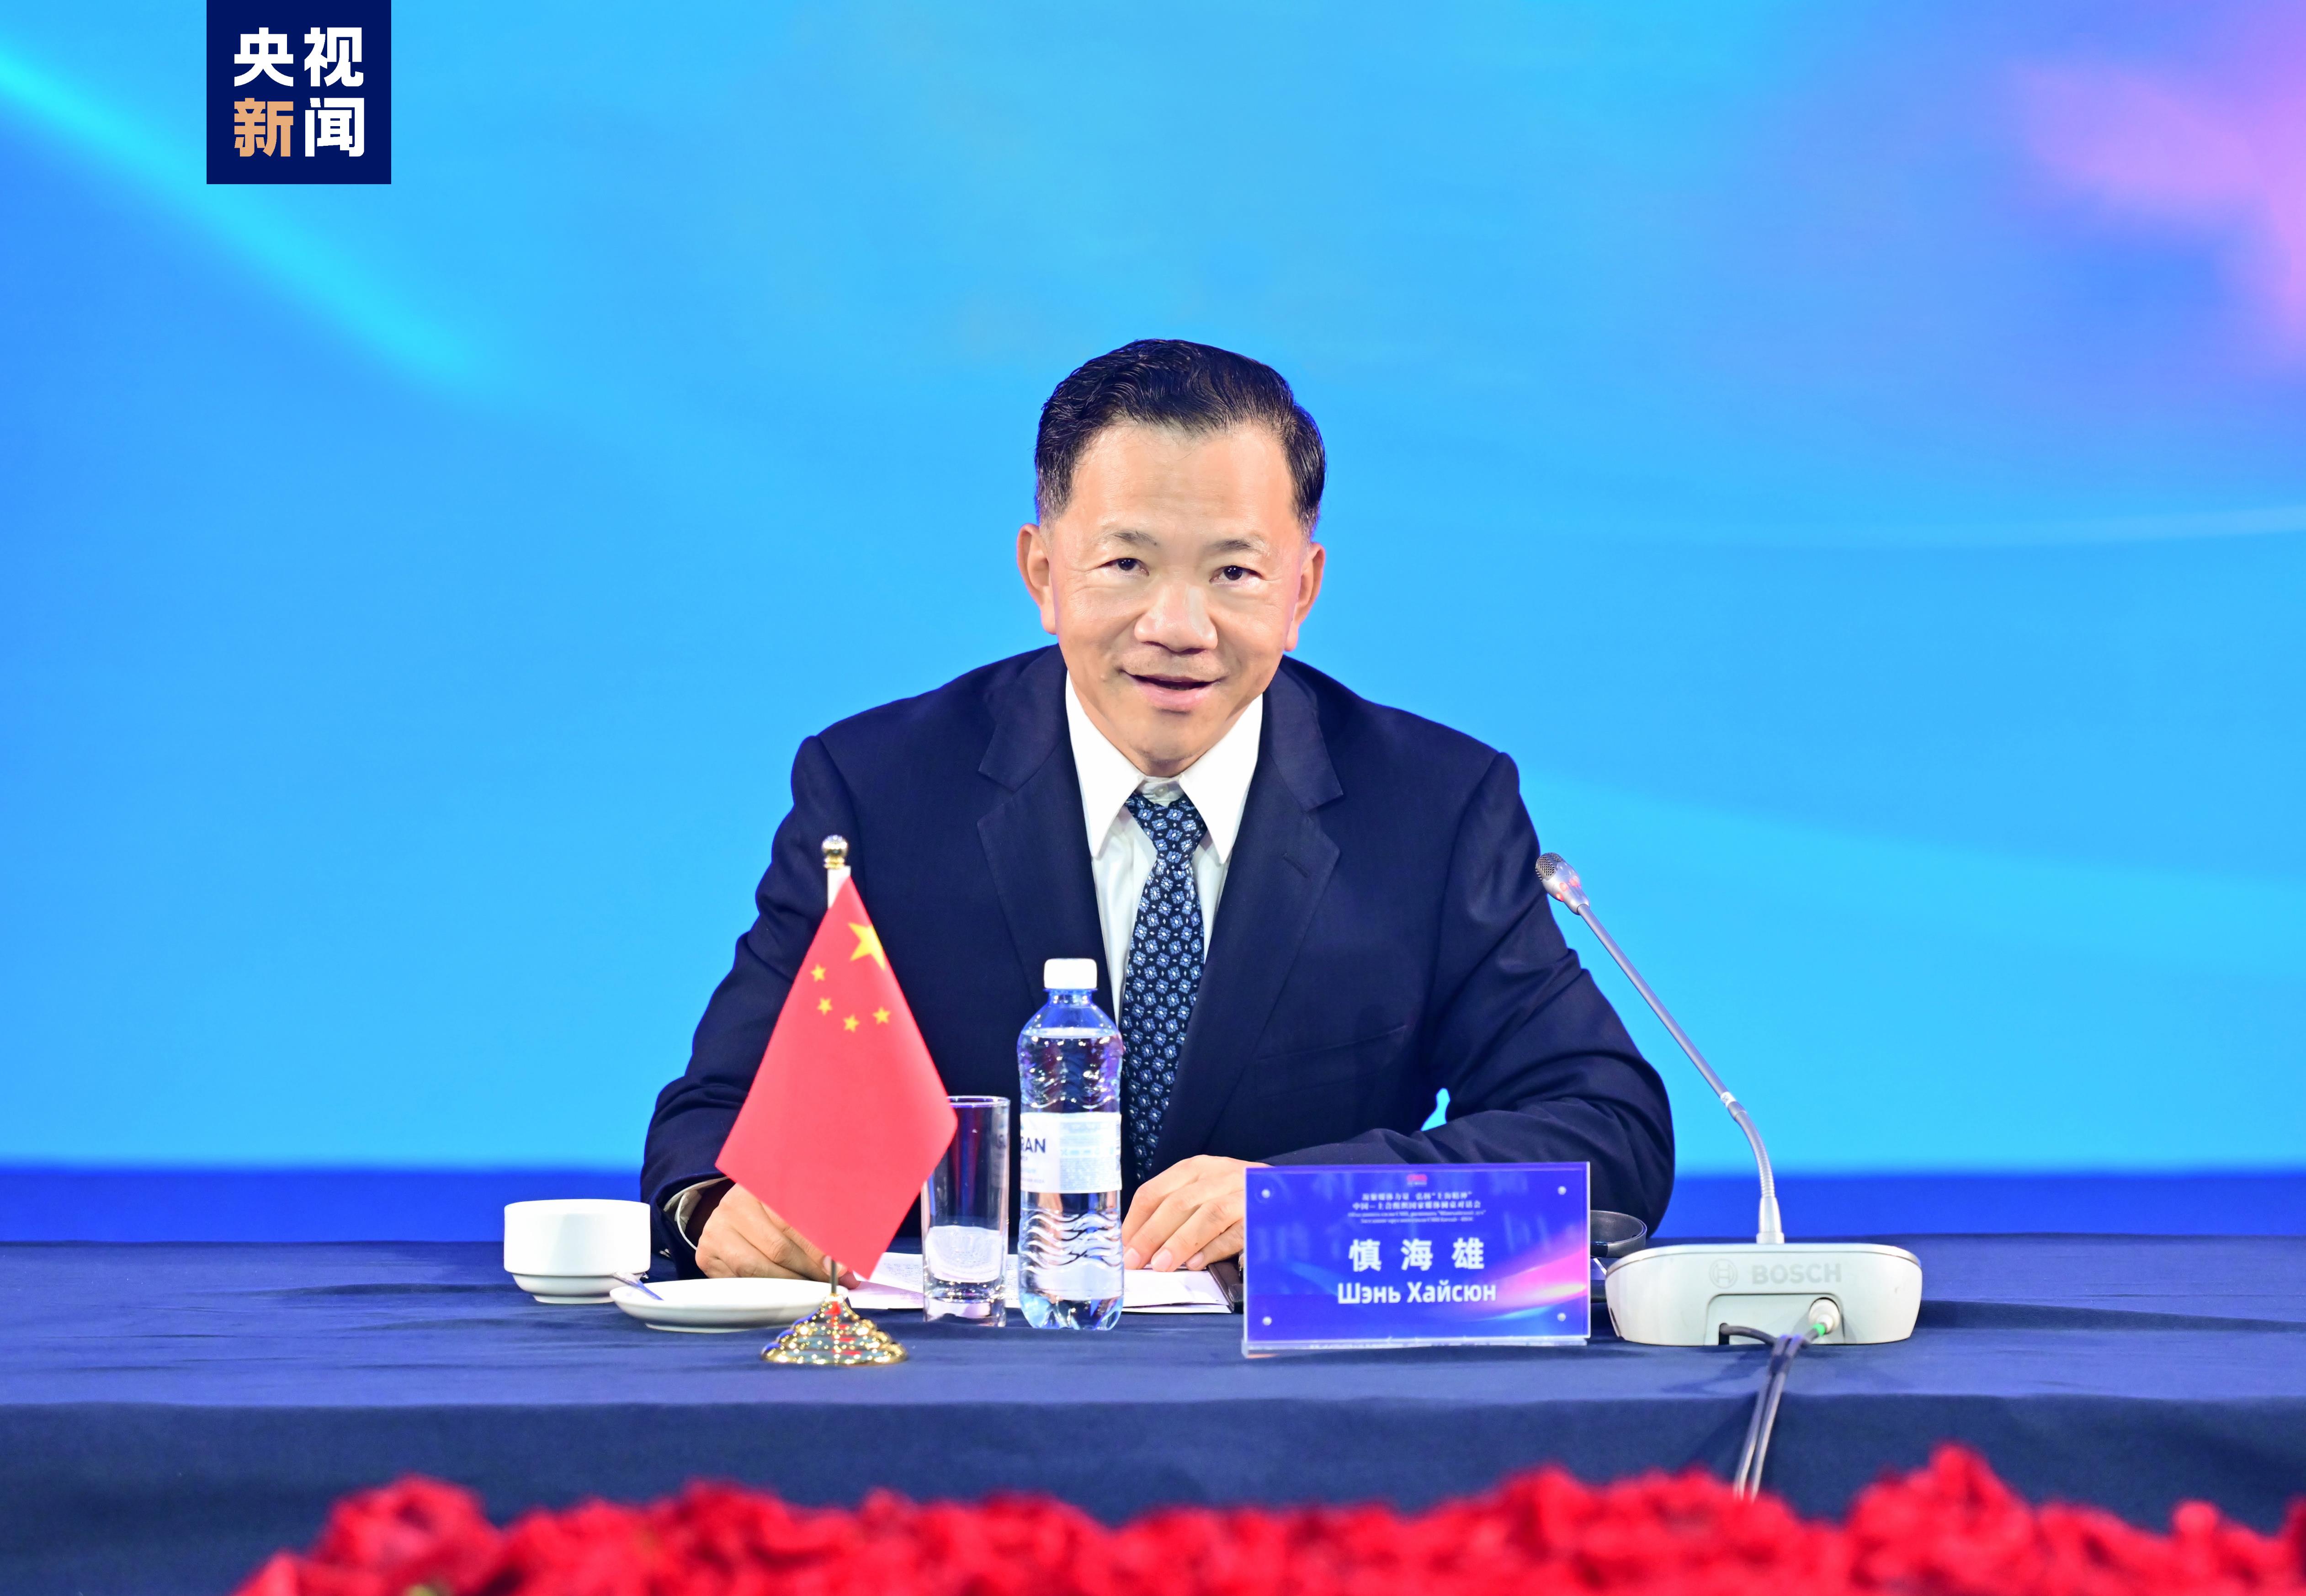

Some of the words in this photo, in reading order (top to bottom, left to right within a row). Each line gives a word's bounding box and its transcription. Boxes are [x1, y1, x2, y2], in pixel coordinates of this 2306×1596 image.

[1751, 1263, 1842, 1285] BOSCH
[1337, 1282, 1401, 1304] Шэнь
[1406, 1280, 1497, 1303] Хайсюн
